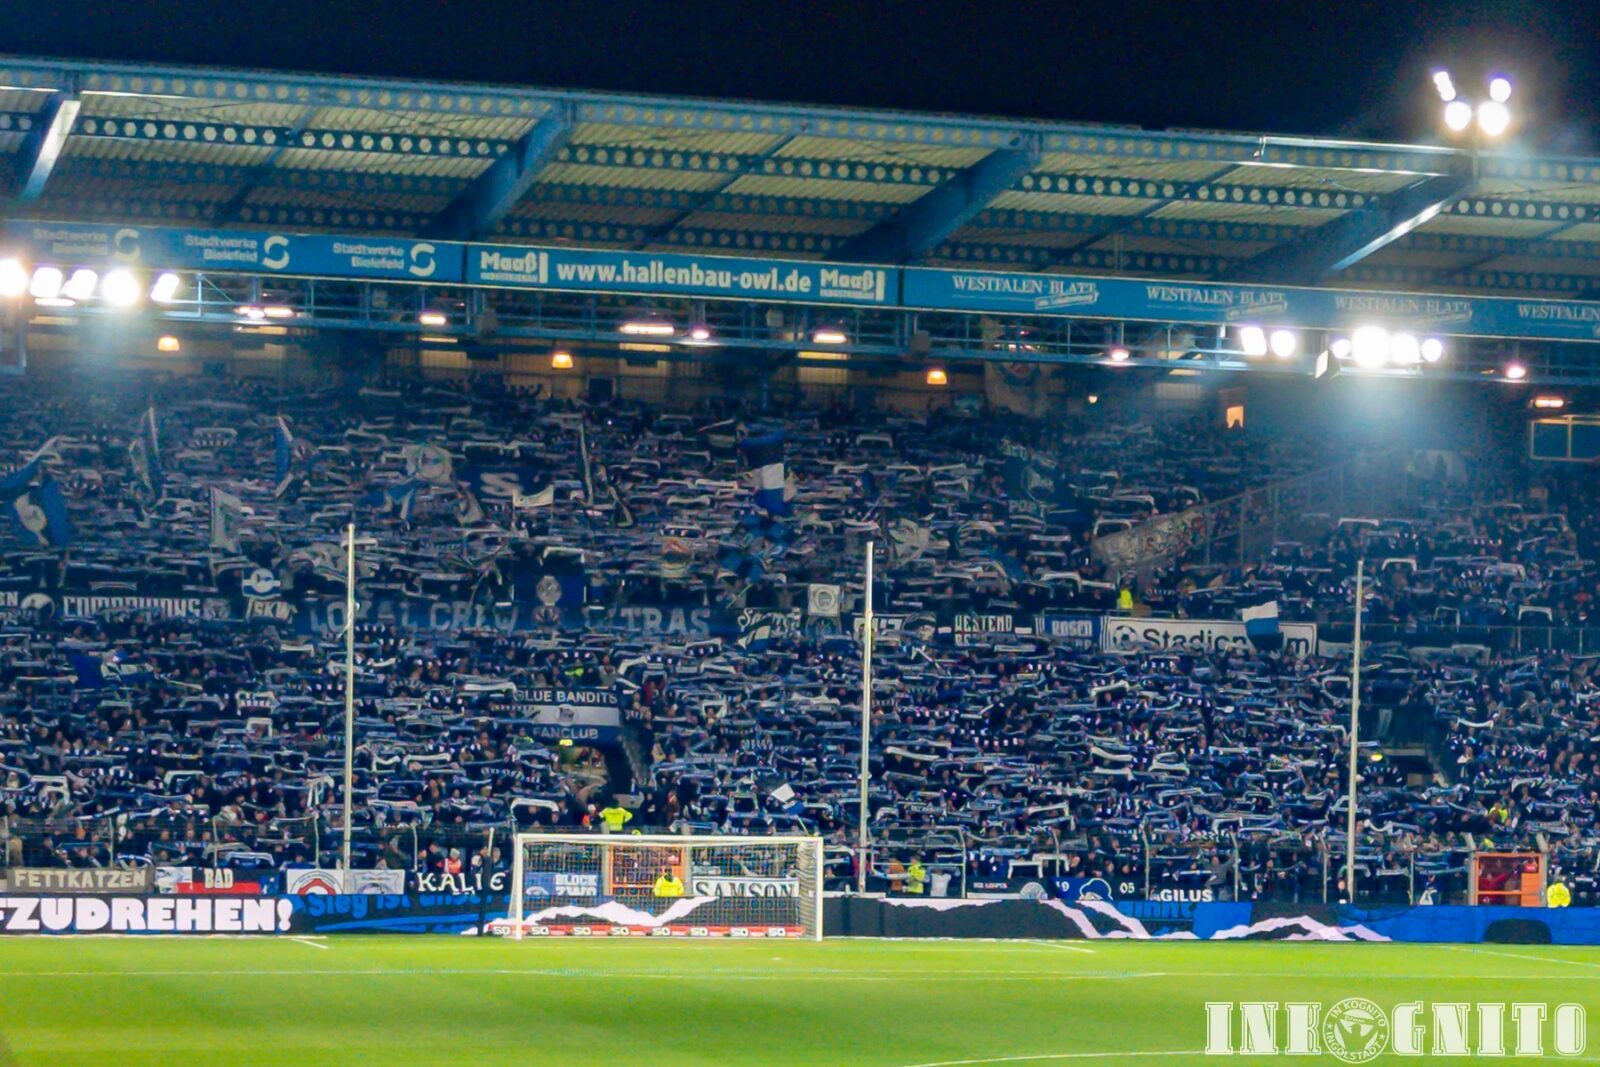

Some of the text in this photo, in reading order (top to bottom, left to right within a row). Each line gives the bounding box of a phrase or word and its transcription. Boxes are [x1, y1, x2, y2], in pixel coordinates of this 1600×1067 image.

[184, 234, 258, 249] Stadtwerke
[333, 242, 404, 256] Stadtwerke
[203, 248, 258, 262] Bielefeld
[351, 256, 404, 269] Bielefeld
[480, 251, 538, 274] Maaß
[556, 260, 812, 293] www.hallenbau-owl.de
[820, 268, 875, 291] Maaß
[556, 690, 618, 704] BANDITS
[533, 727, 598, 739] FANCLUB
[14, 869, 147, 888] FETTKATZEN
[204, 867, 234, 889] BAD
[695, 881, 794, 897] SAMSON
[1119, 882, 1135, 894] 05
[0, 897, 294, 931] ZUDREHEN!
